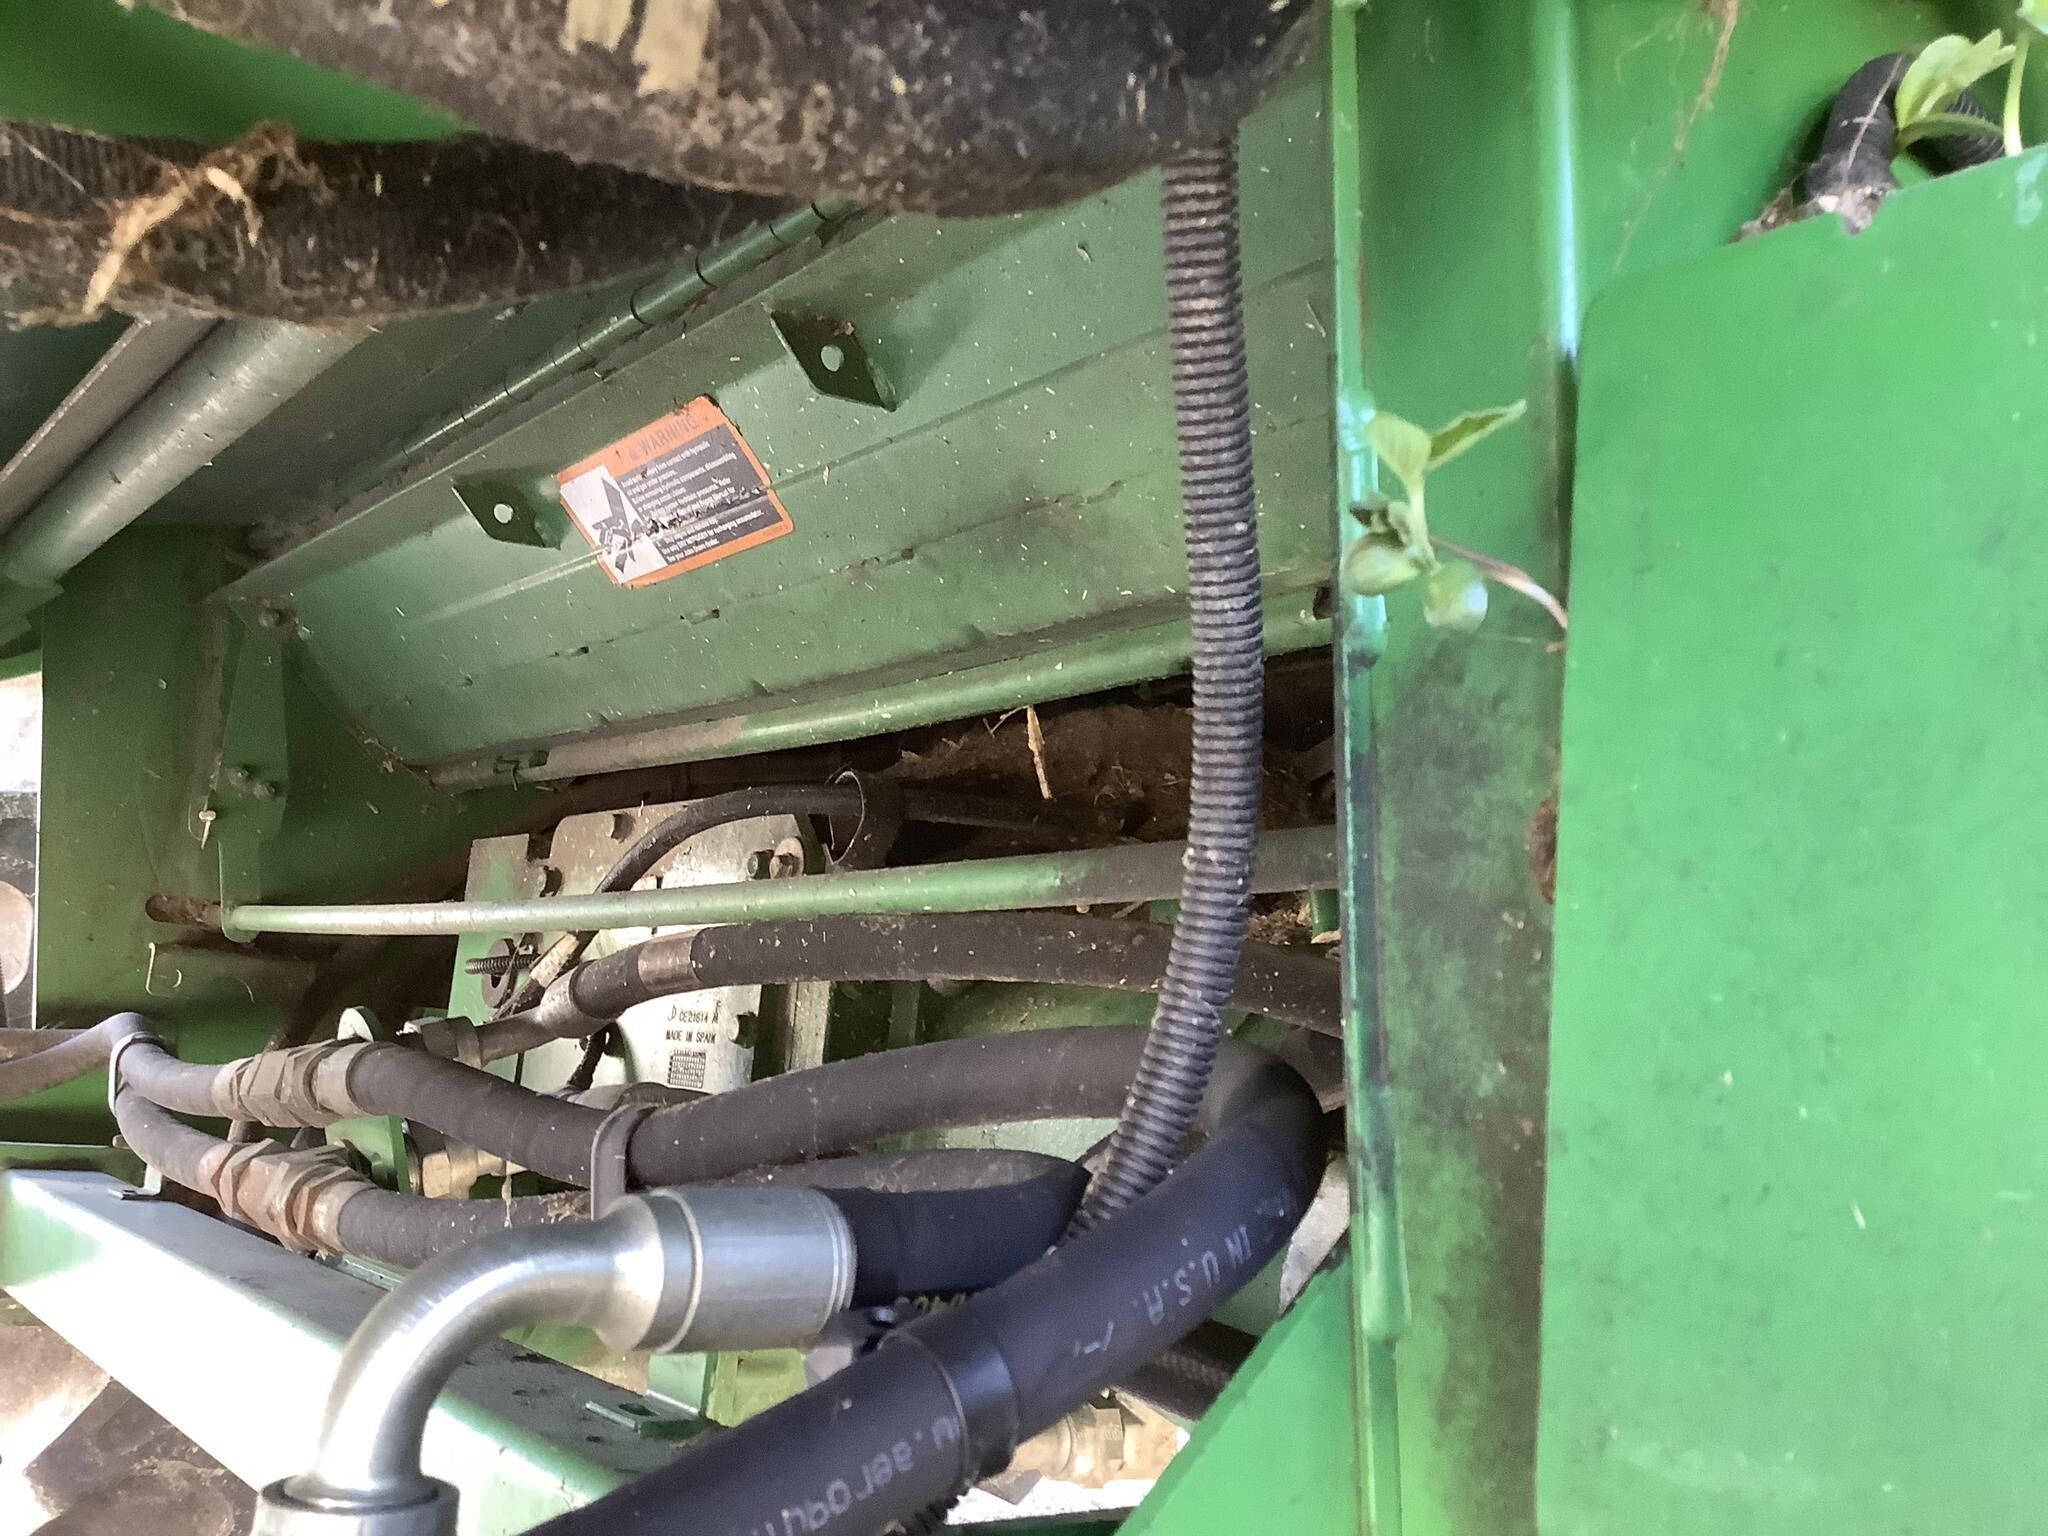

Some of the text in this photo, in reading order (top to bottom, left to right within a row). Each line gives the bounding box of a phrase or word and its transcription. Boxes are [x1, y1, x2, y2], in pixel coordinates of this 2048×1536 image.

[640, 411, 700, 455] WARNING
[666, 1029, 717, 1045] MADE IN SPAIN
